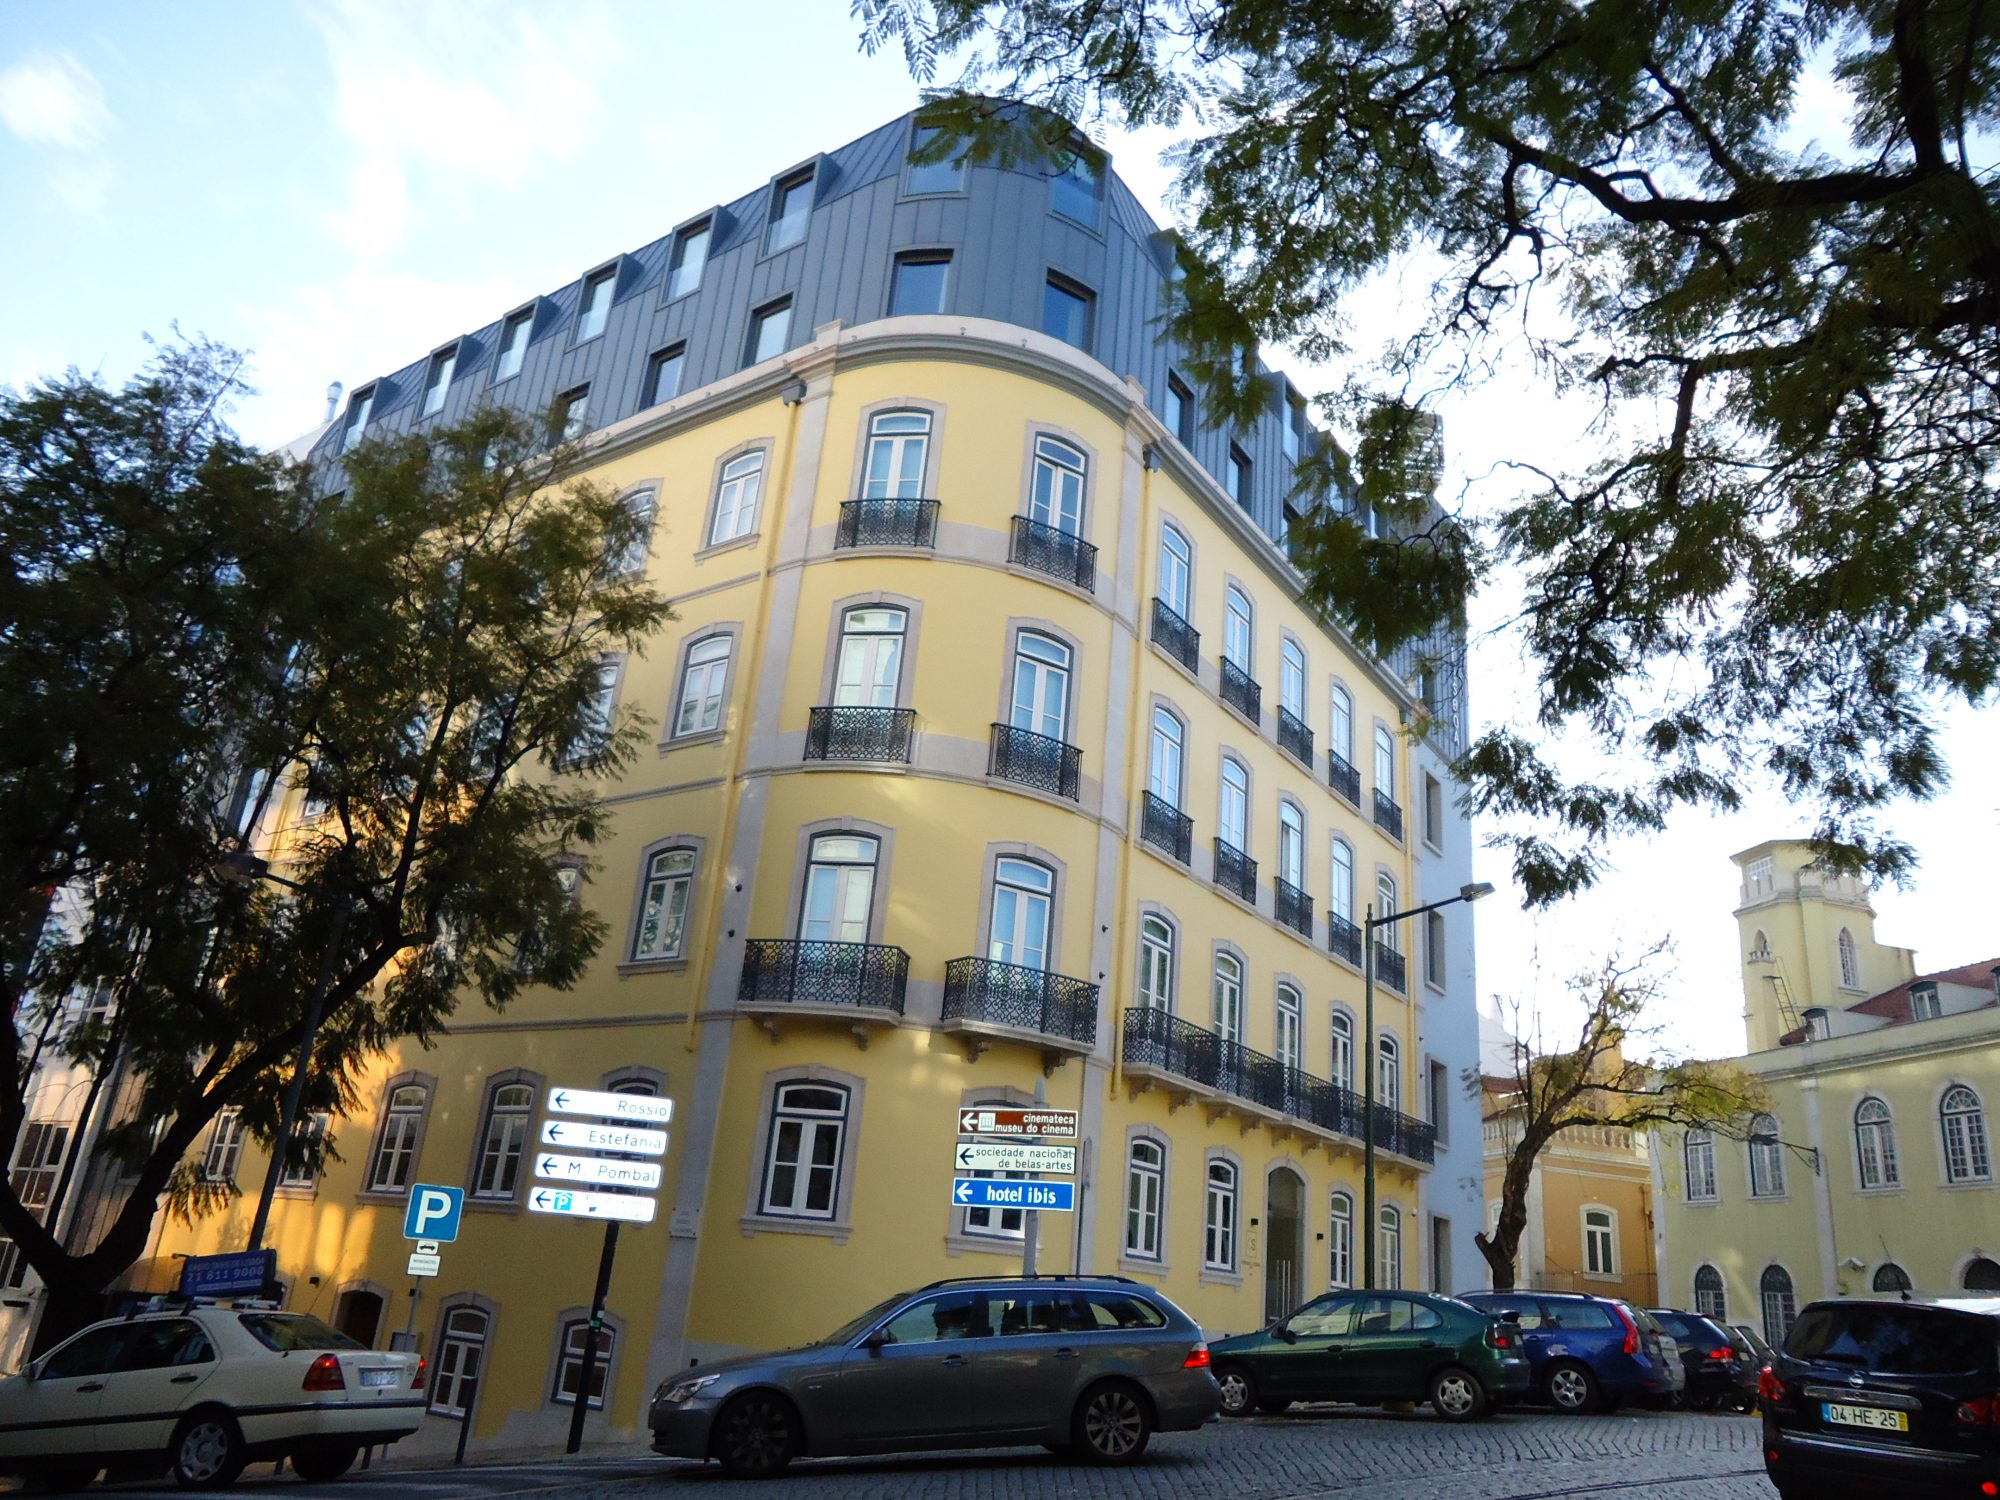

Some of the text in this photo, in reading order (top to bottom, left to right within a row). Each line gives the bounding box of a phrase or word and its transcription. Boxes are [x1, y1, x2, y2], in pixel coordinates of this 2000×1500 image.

[617, 1099, 667, 1117] Rossio
[1023, 1113, 1074, 1124] cinemateca
[995, 1123, 1074, 1135] museu do cinema
[975, 1147, 1073, 1159] sociedade nacional
[998, 1158, 1072, 1170] de belas-artes
[597, 1164, 656, 1182] Pombal
[986, 1184, 1057, 1204] hotel ibis
[415, 1190, 452, 1234] P
